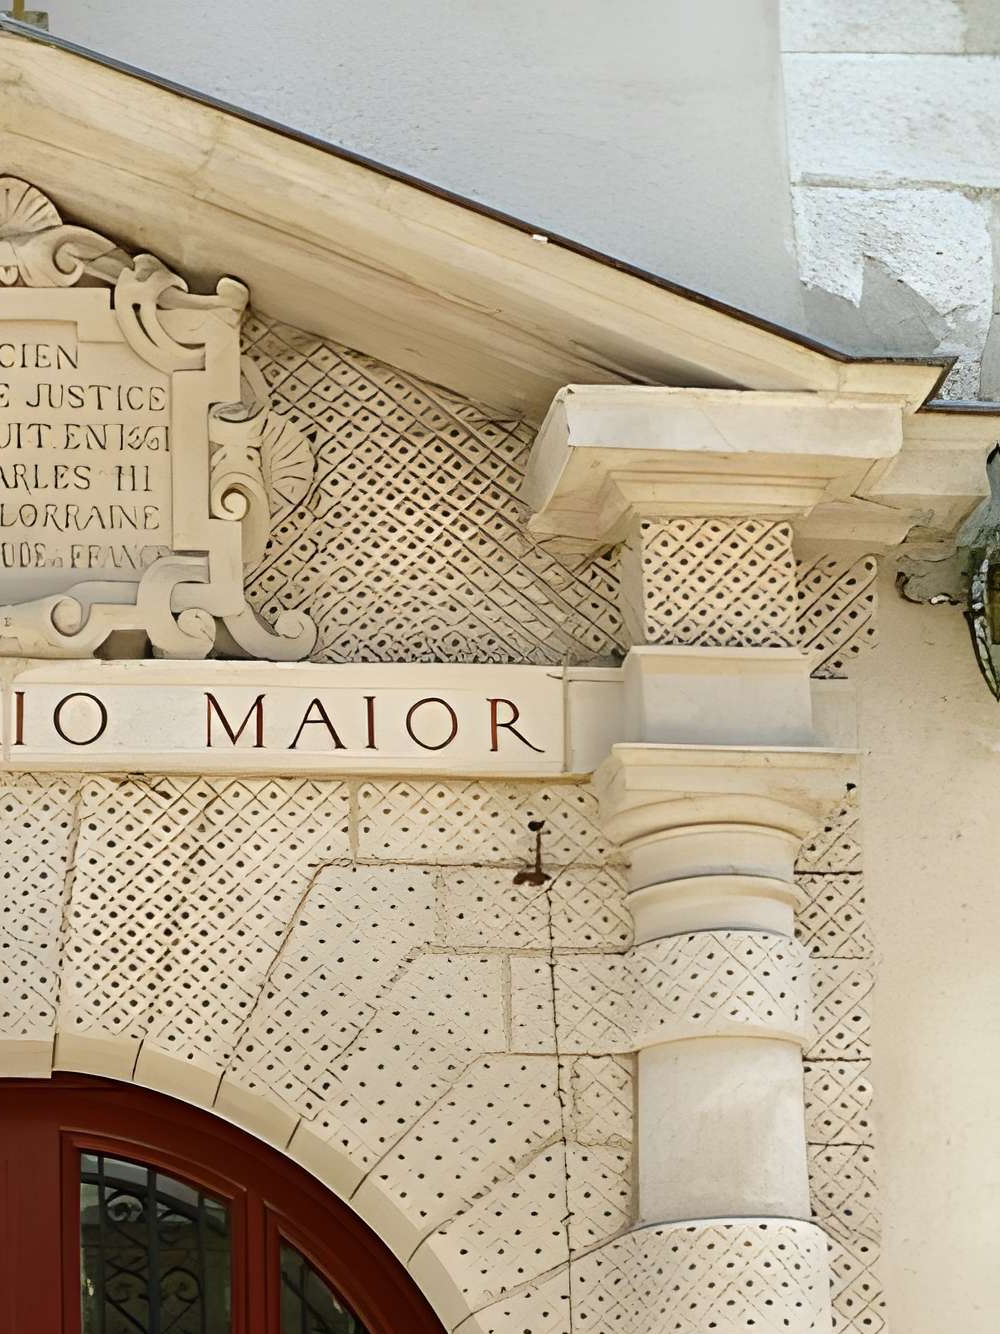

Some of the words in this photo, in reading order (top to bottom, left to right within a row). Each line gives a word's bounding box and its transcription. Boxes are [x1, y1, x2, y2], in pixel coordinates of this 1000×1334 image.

[26, 384, 166, 411] JUSTICE
[63, 423, 108, 451] EN
[0, 503, 161, 532] LORRAINE
[205, 692, 545, 754] MAIOR
